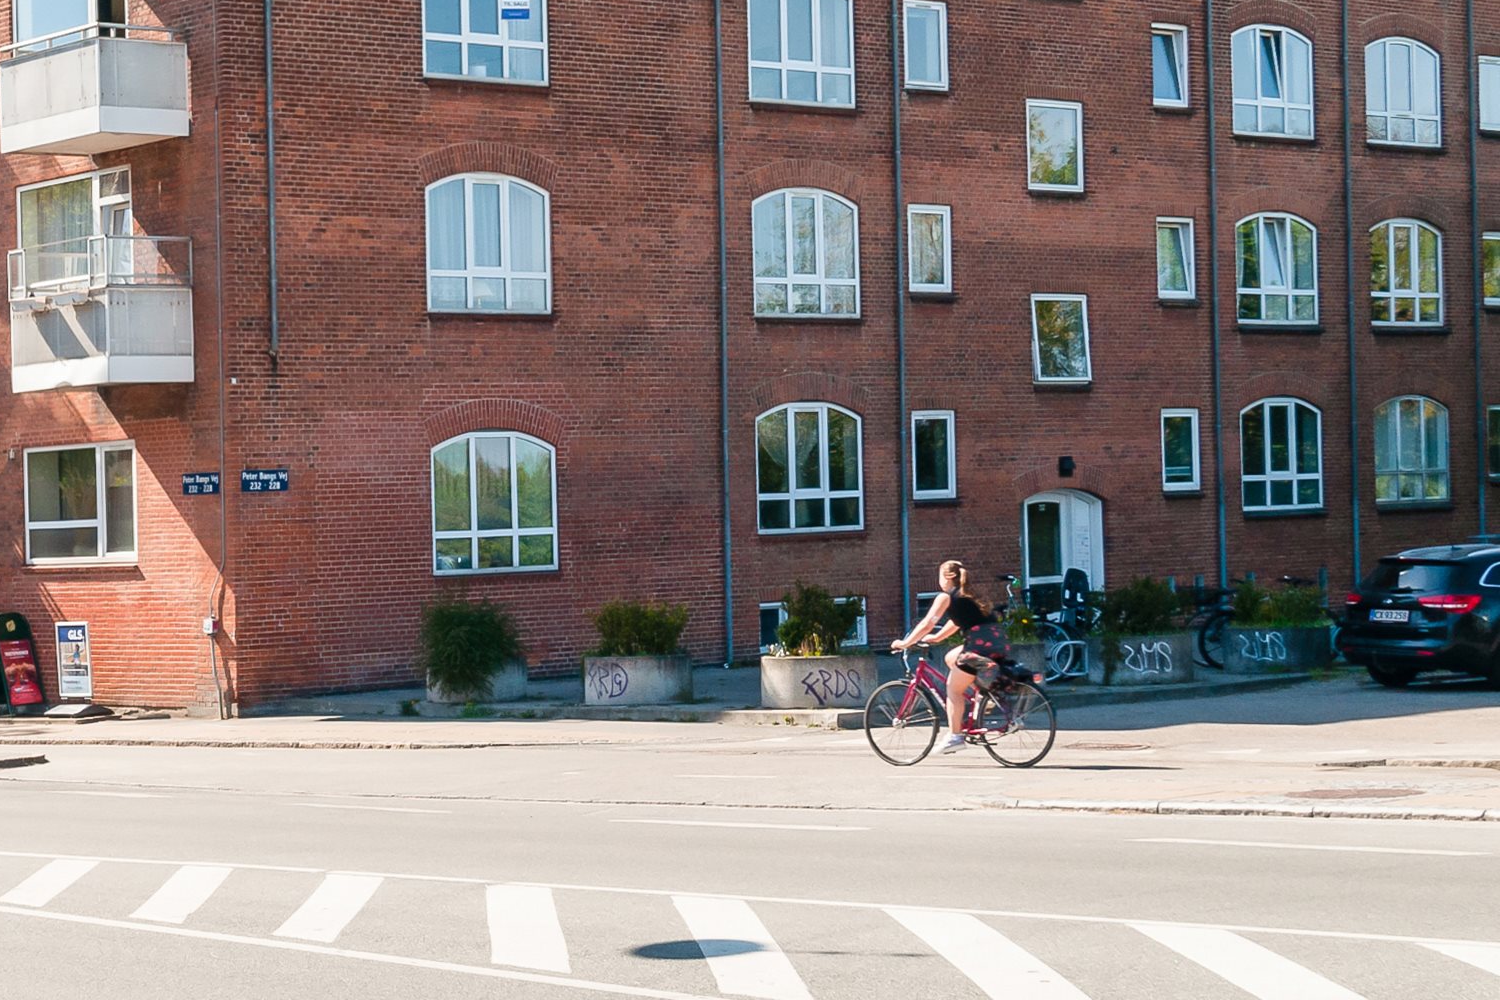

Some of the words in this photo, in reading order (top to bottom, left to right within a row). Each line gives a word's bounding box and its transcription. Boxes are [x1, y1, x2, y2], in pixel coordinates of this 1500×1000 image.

[242, 472, 257, 480] Peter
[259, 472, 276, 482] Bangs
[278, 472, 288, 481] Vej
[249, 482, 261, 490] 232
